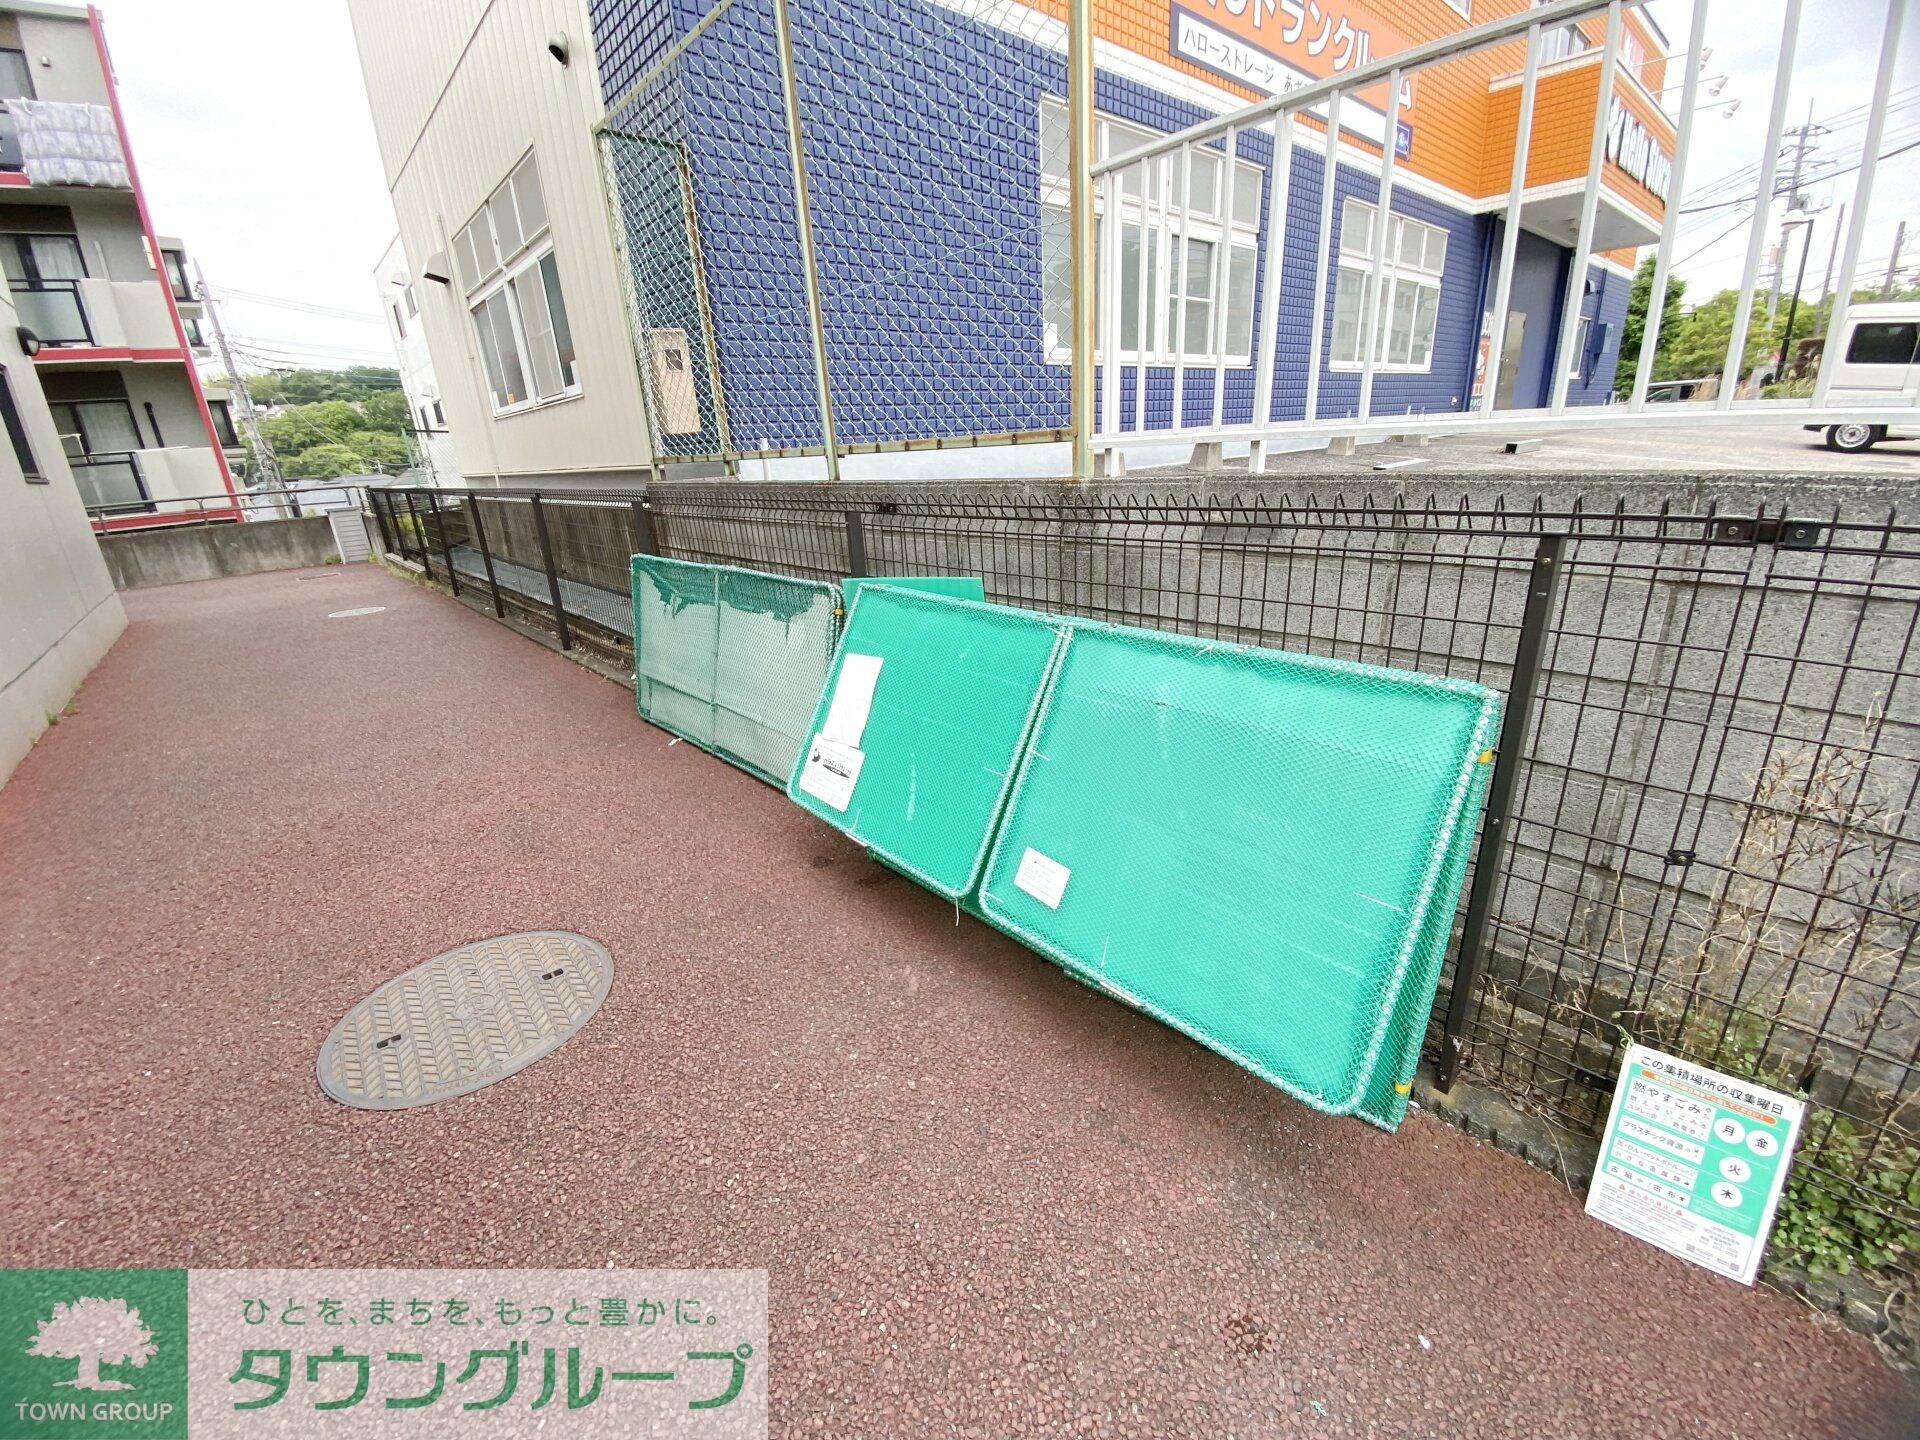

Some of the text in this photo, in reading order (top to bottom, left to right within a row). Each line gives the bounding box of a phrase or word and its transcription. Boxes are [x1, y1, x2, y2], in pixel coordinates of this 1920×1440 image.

[1183, 27, 1275, 84] ハローストレージ
[1633, 1081, 1702, 1115] 燃やすごみ
[1640, 1055, 1784, 1116] この集積場所の収集曜日
[1623, 1120, 1684, 1151] プラスチック資源
[1722, 1124, 1770, 1149] 月 金
[1727, 1162, 1742, 1176] 火
[1720, 1187, 1735, 1200] 木
